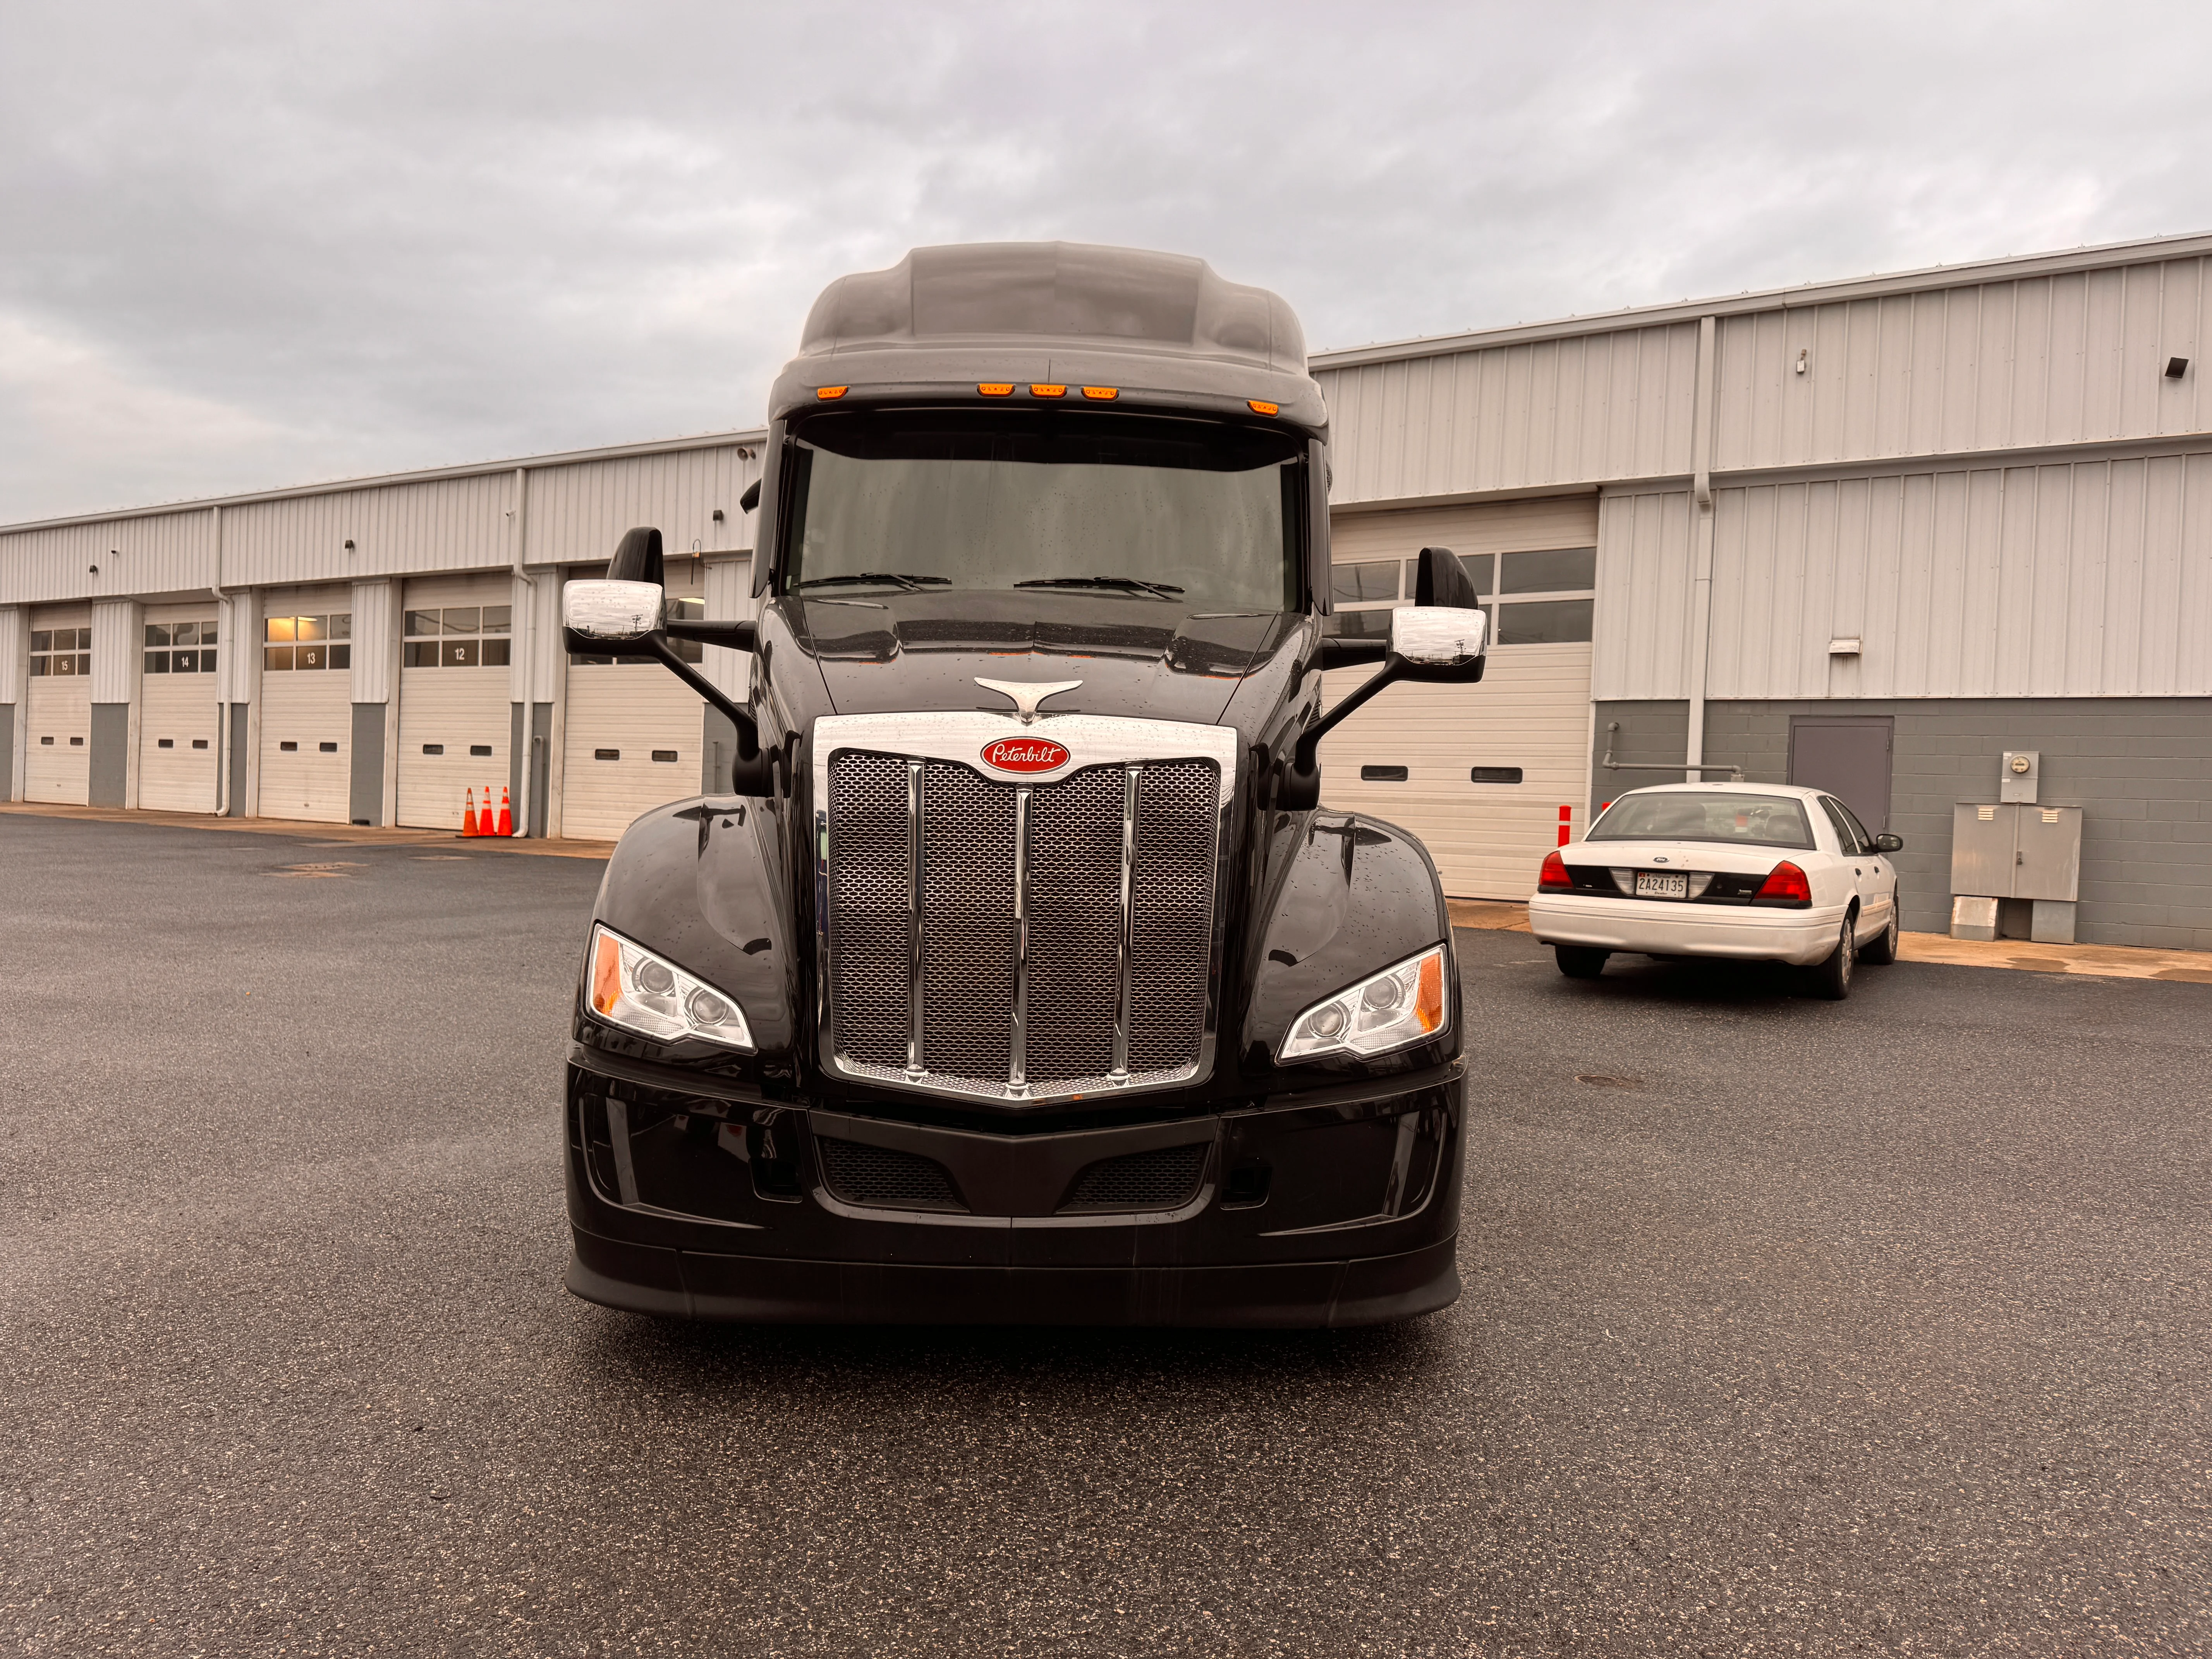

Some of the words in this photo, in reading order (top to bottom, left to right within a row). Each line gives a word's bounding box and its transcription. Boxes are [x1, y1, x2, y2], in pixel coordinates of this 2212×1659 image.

[307, 652, 316, 664] 13
[455, 647, 465, 660] 12
[62, 660, 68, 670] 15
[181, 656, 189, 667] 14
[992, 744, 1061, 763] Peterbilt
[1638, 878, 1684, 892] 2A24135
